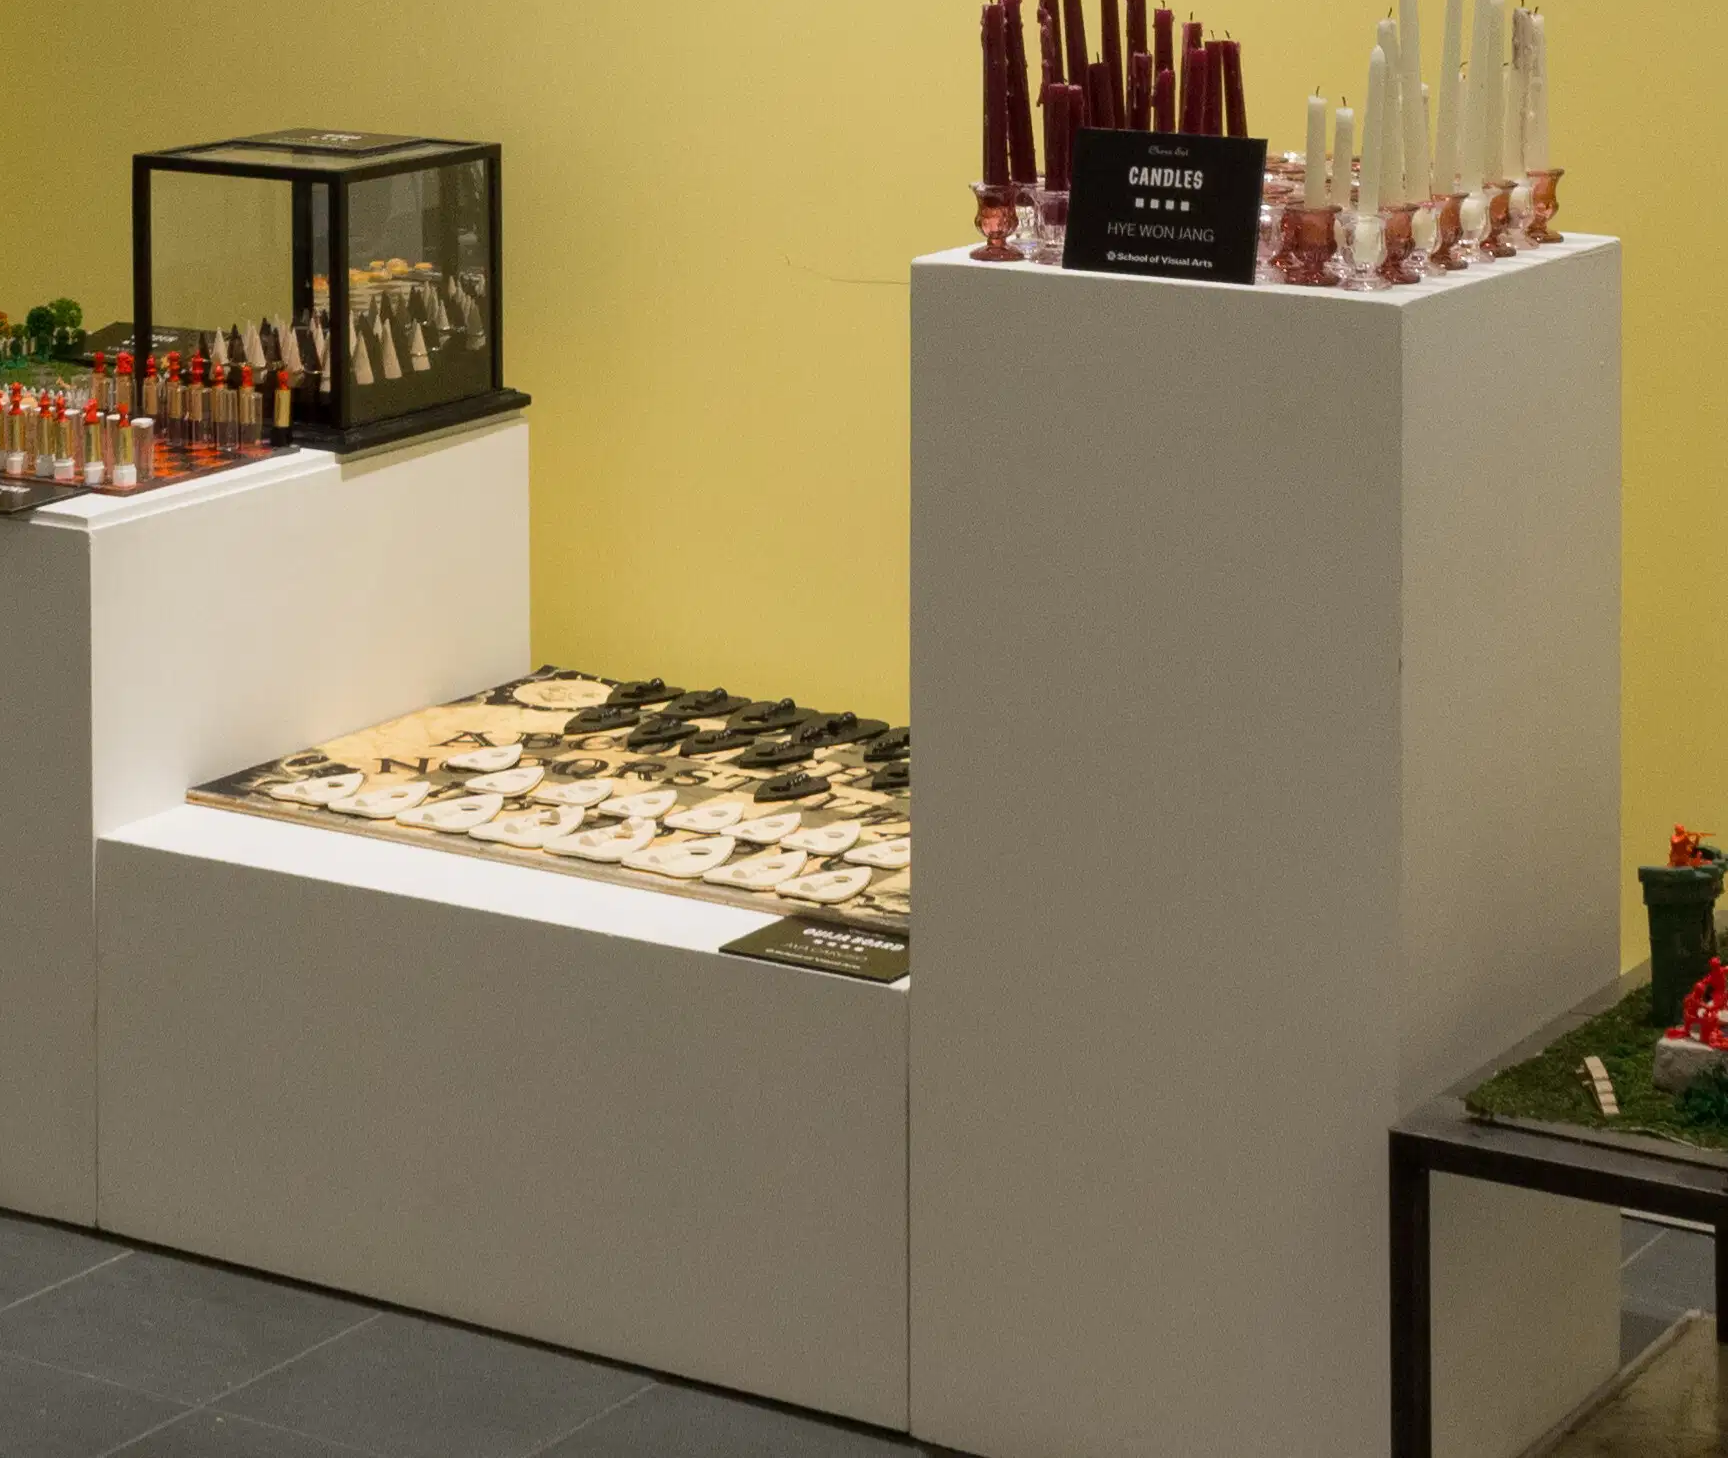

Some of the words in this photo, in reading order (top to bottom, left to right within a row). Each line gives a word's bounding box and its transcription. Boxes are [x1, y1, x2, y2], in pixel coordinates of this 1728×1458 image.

[1128, 166, 1204, 190] CANDLES
[1107, 222, 1137, 237] HYE
[1139, 224, 1175, 240] WON
[1178, 227, 1215, 243] JANG
[1117, 252, 1148, 263] School
[1149, 254, 1159, 263] of
[1161, 255, 1190, 267] Visual
[1191, 257, 1214, 269] Arts
